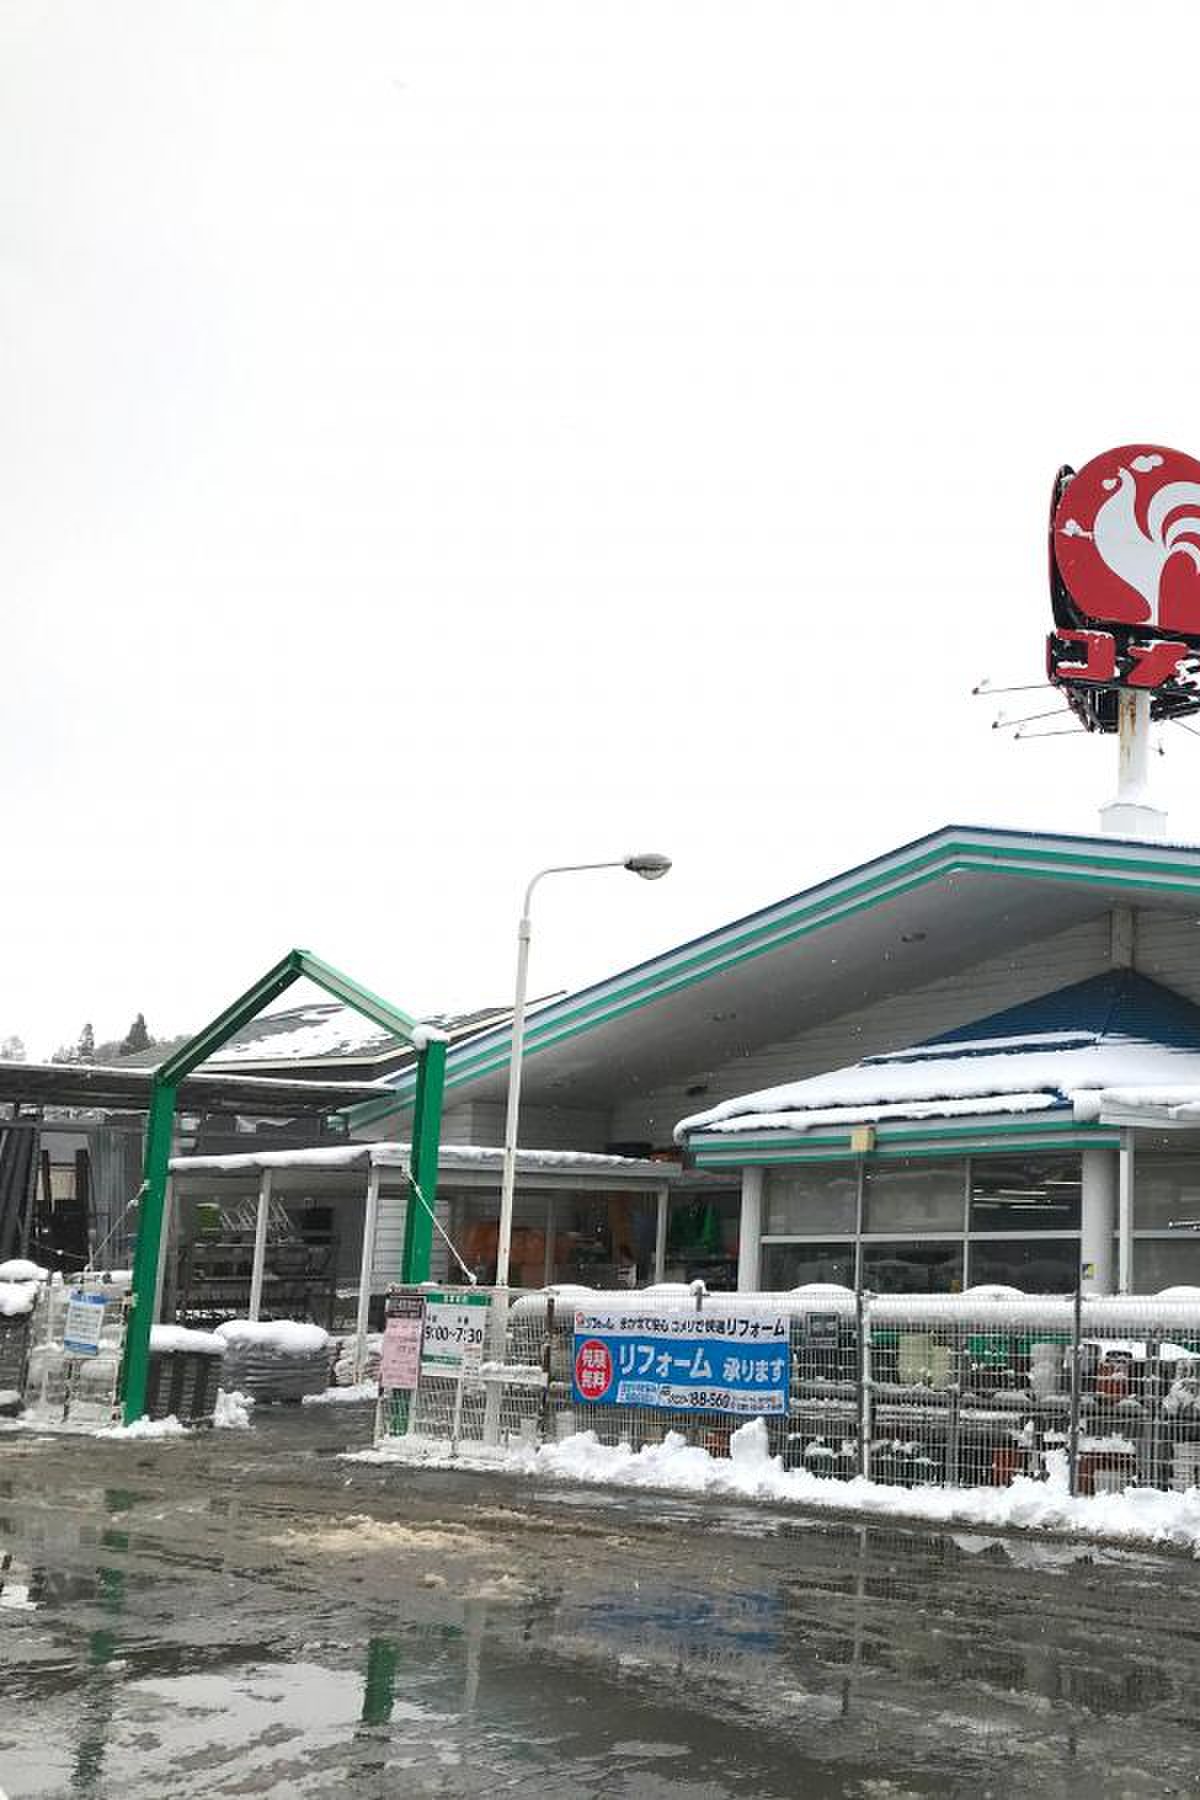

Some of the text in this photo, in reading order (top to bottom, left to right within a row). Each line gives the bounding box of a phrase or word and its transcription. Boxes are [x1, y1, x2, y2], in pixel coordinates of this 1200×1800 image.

[619, 1344, 785, 1383] リフォーム 承ります
